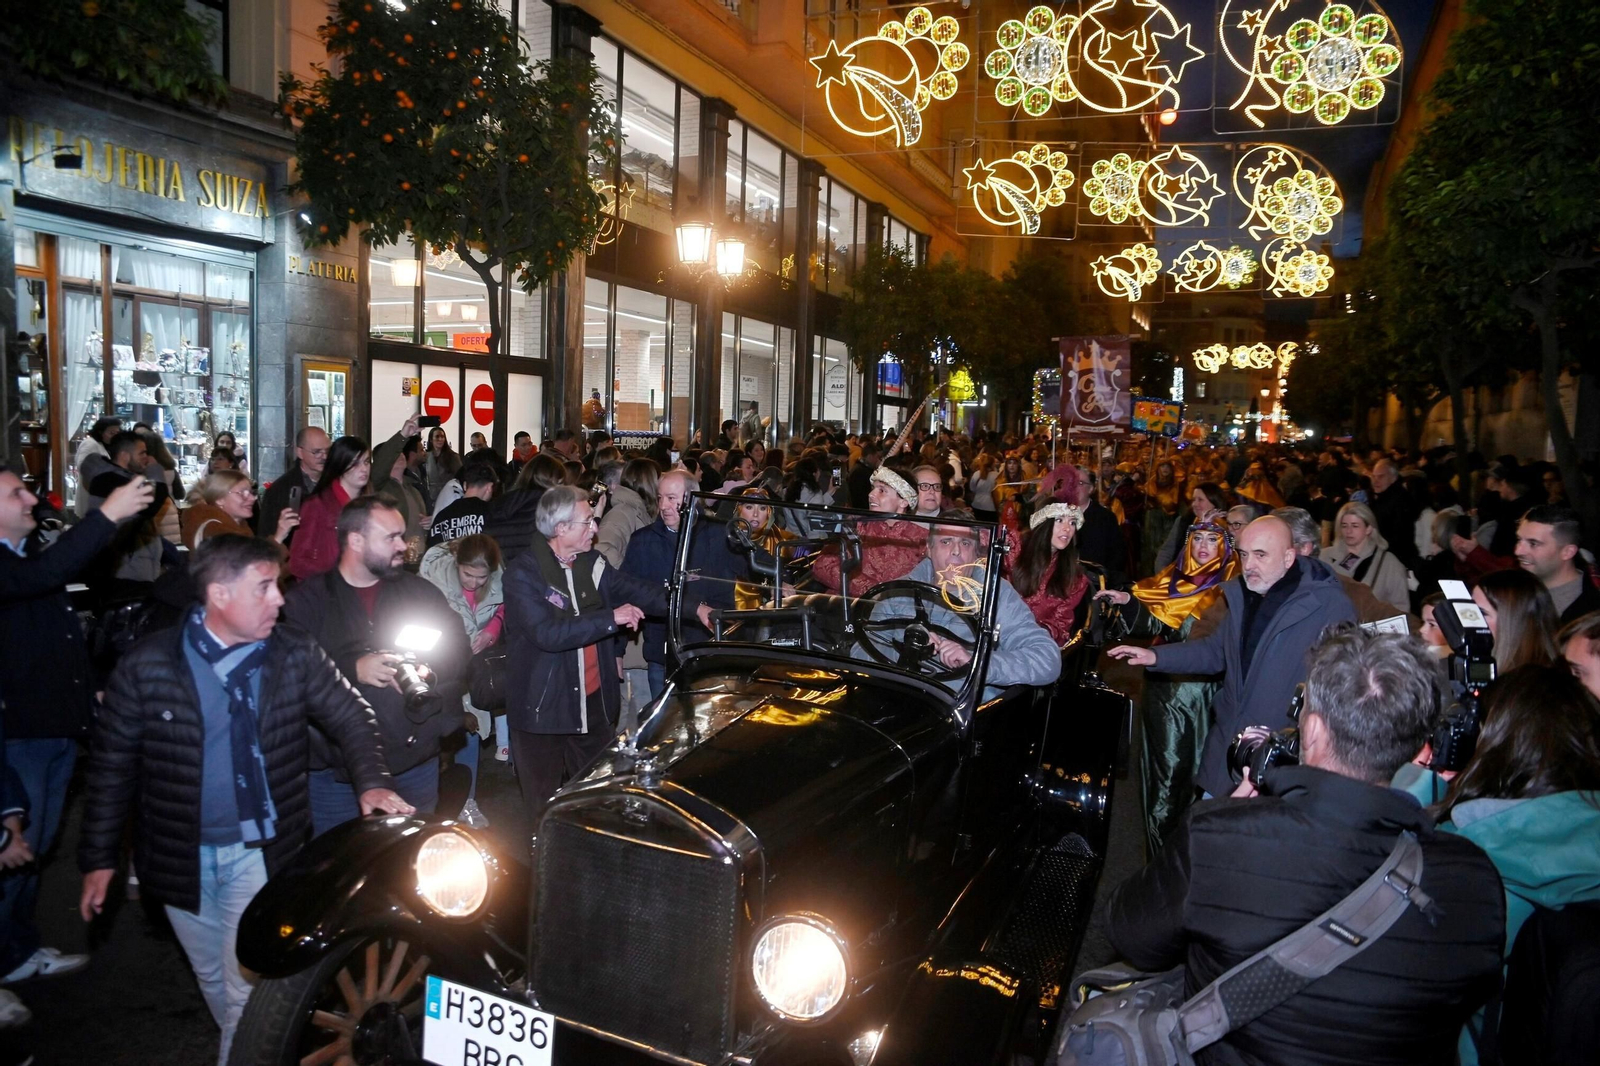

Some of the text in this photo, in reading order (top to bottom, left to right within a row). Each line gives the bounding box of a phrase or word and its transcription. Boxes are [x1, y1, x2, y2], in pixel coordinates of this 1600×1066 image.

[9, 116, 270, 218] RELOJERIA SUIZA
[289, 256, 358, 283] PLATERIA
[431, 514, 485, 537] LET'S EMBRA
[441, 528, 454, 541] THE
[429, 1002, 438, 1012] E
[446, 987, 548, 1049] H3836
